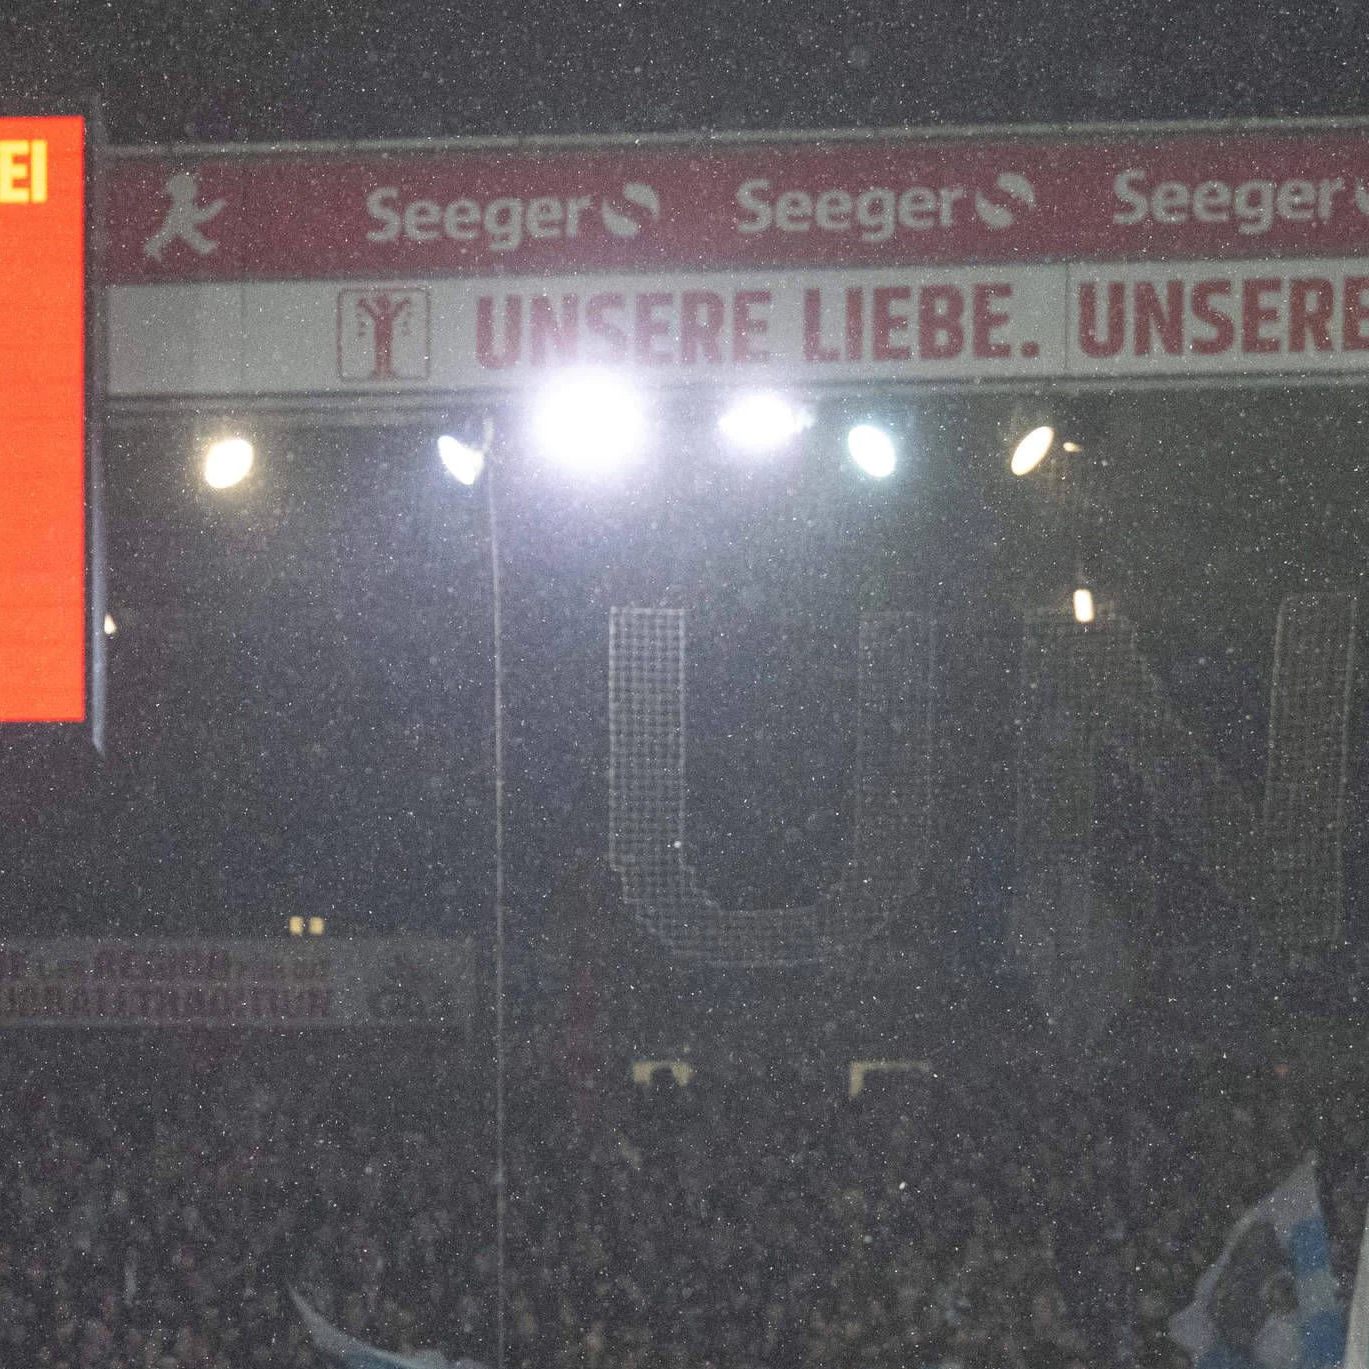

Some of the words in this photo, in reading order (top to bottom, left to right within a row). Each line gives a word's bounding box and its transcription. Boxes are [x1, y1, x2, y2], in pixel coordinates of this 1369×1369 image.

[367, 187, 592, 250] Seeger
[736, 176, 965, 241] Seeger
[1112, 168, 1345, 236] Seeger
[475, 286, 773, 369] UNSERE
[802, 280, 1040, 363] LIEBE.
[1078, 276, 1369, 358] UNSERE
